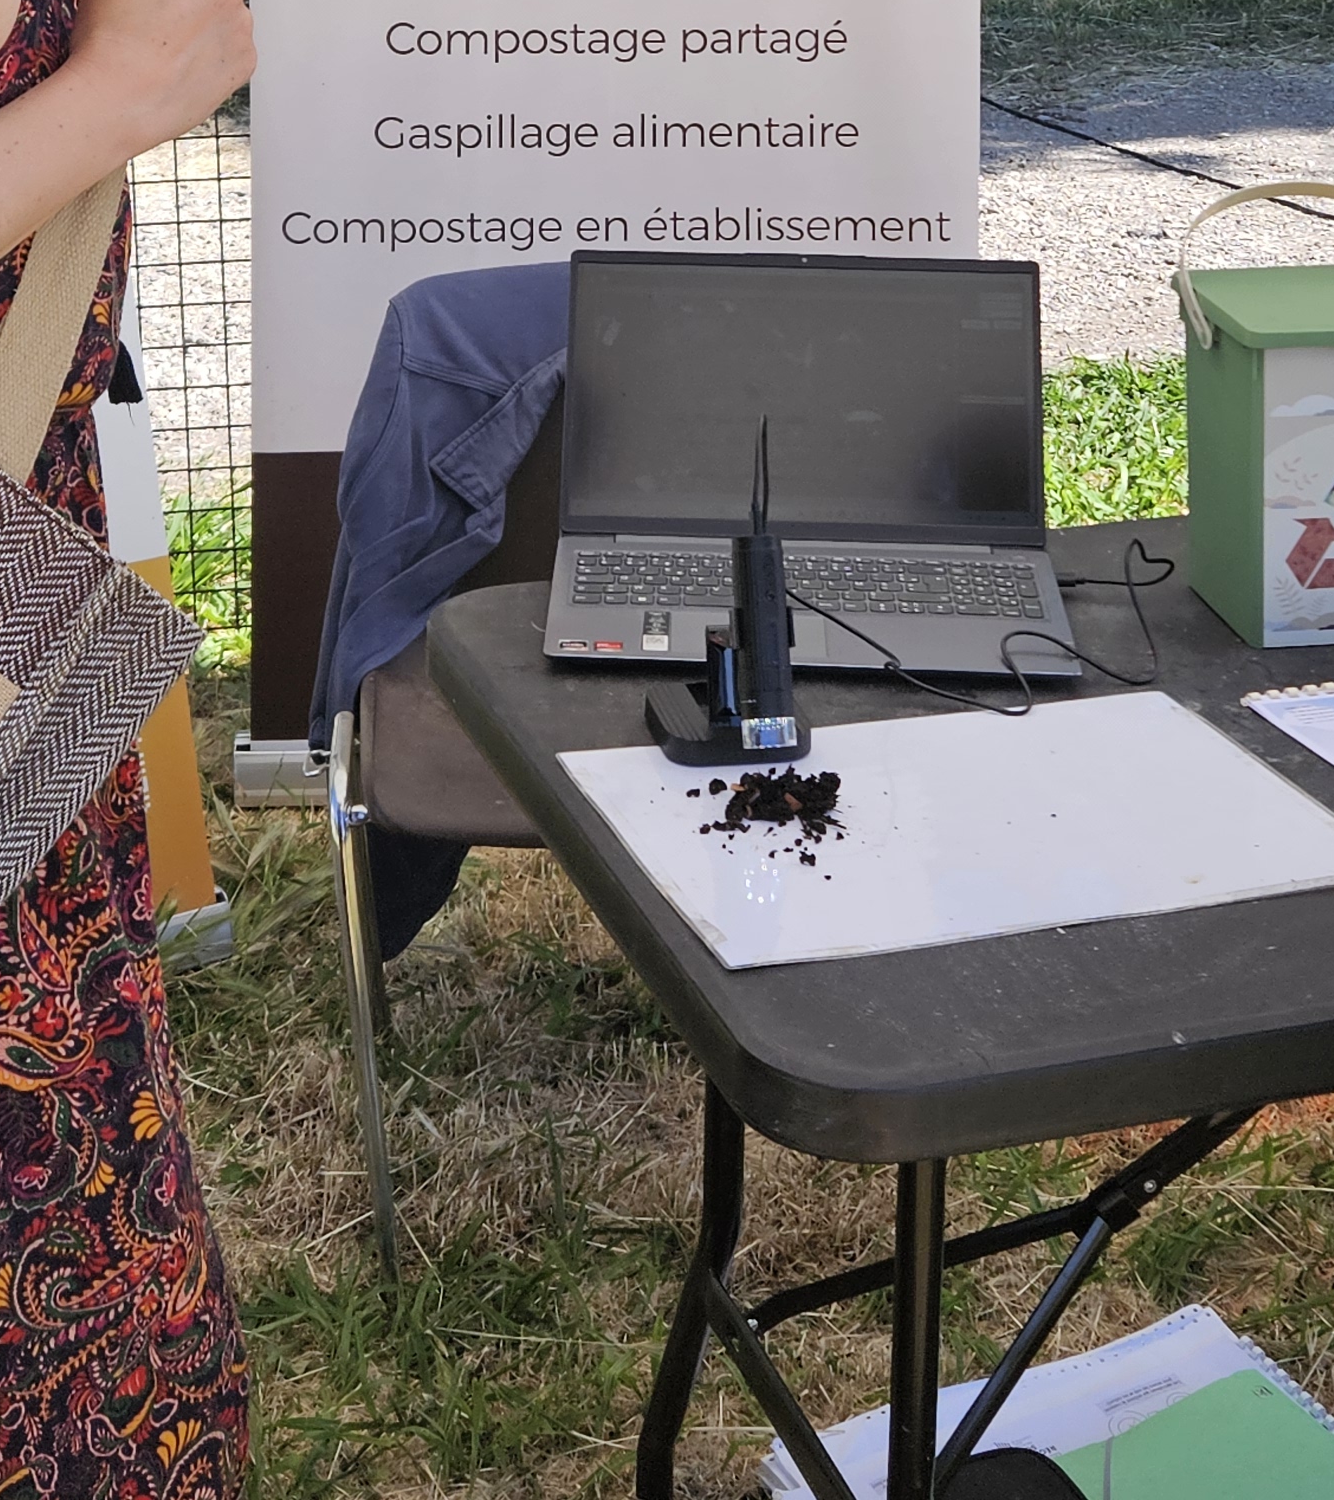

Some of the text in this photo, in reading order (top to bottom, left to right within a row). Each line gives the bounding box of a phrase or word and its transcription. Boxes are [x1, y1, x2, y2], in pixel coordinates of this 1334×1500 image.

[385, 19, 849, 63] Compostage partagé
[373, 113, 860, 158] Gaspillage alimentaire
[281, 207, 952, 251] Compostage en établissement
